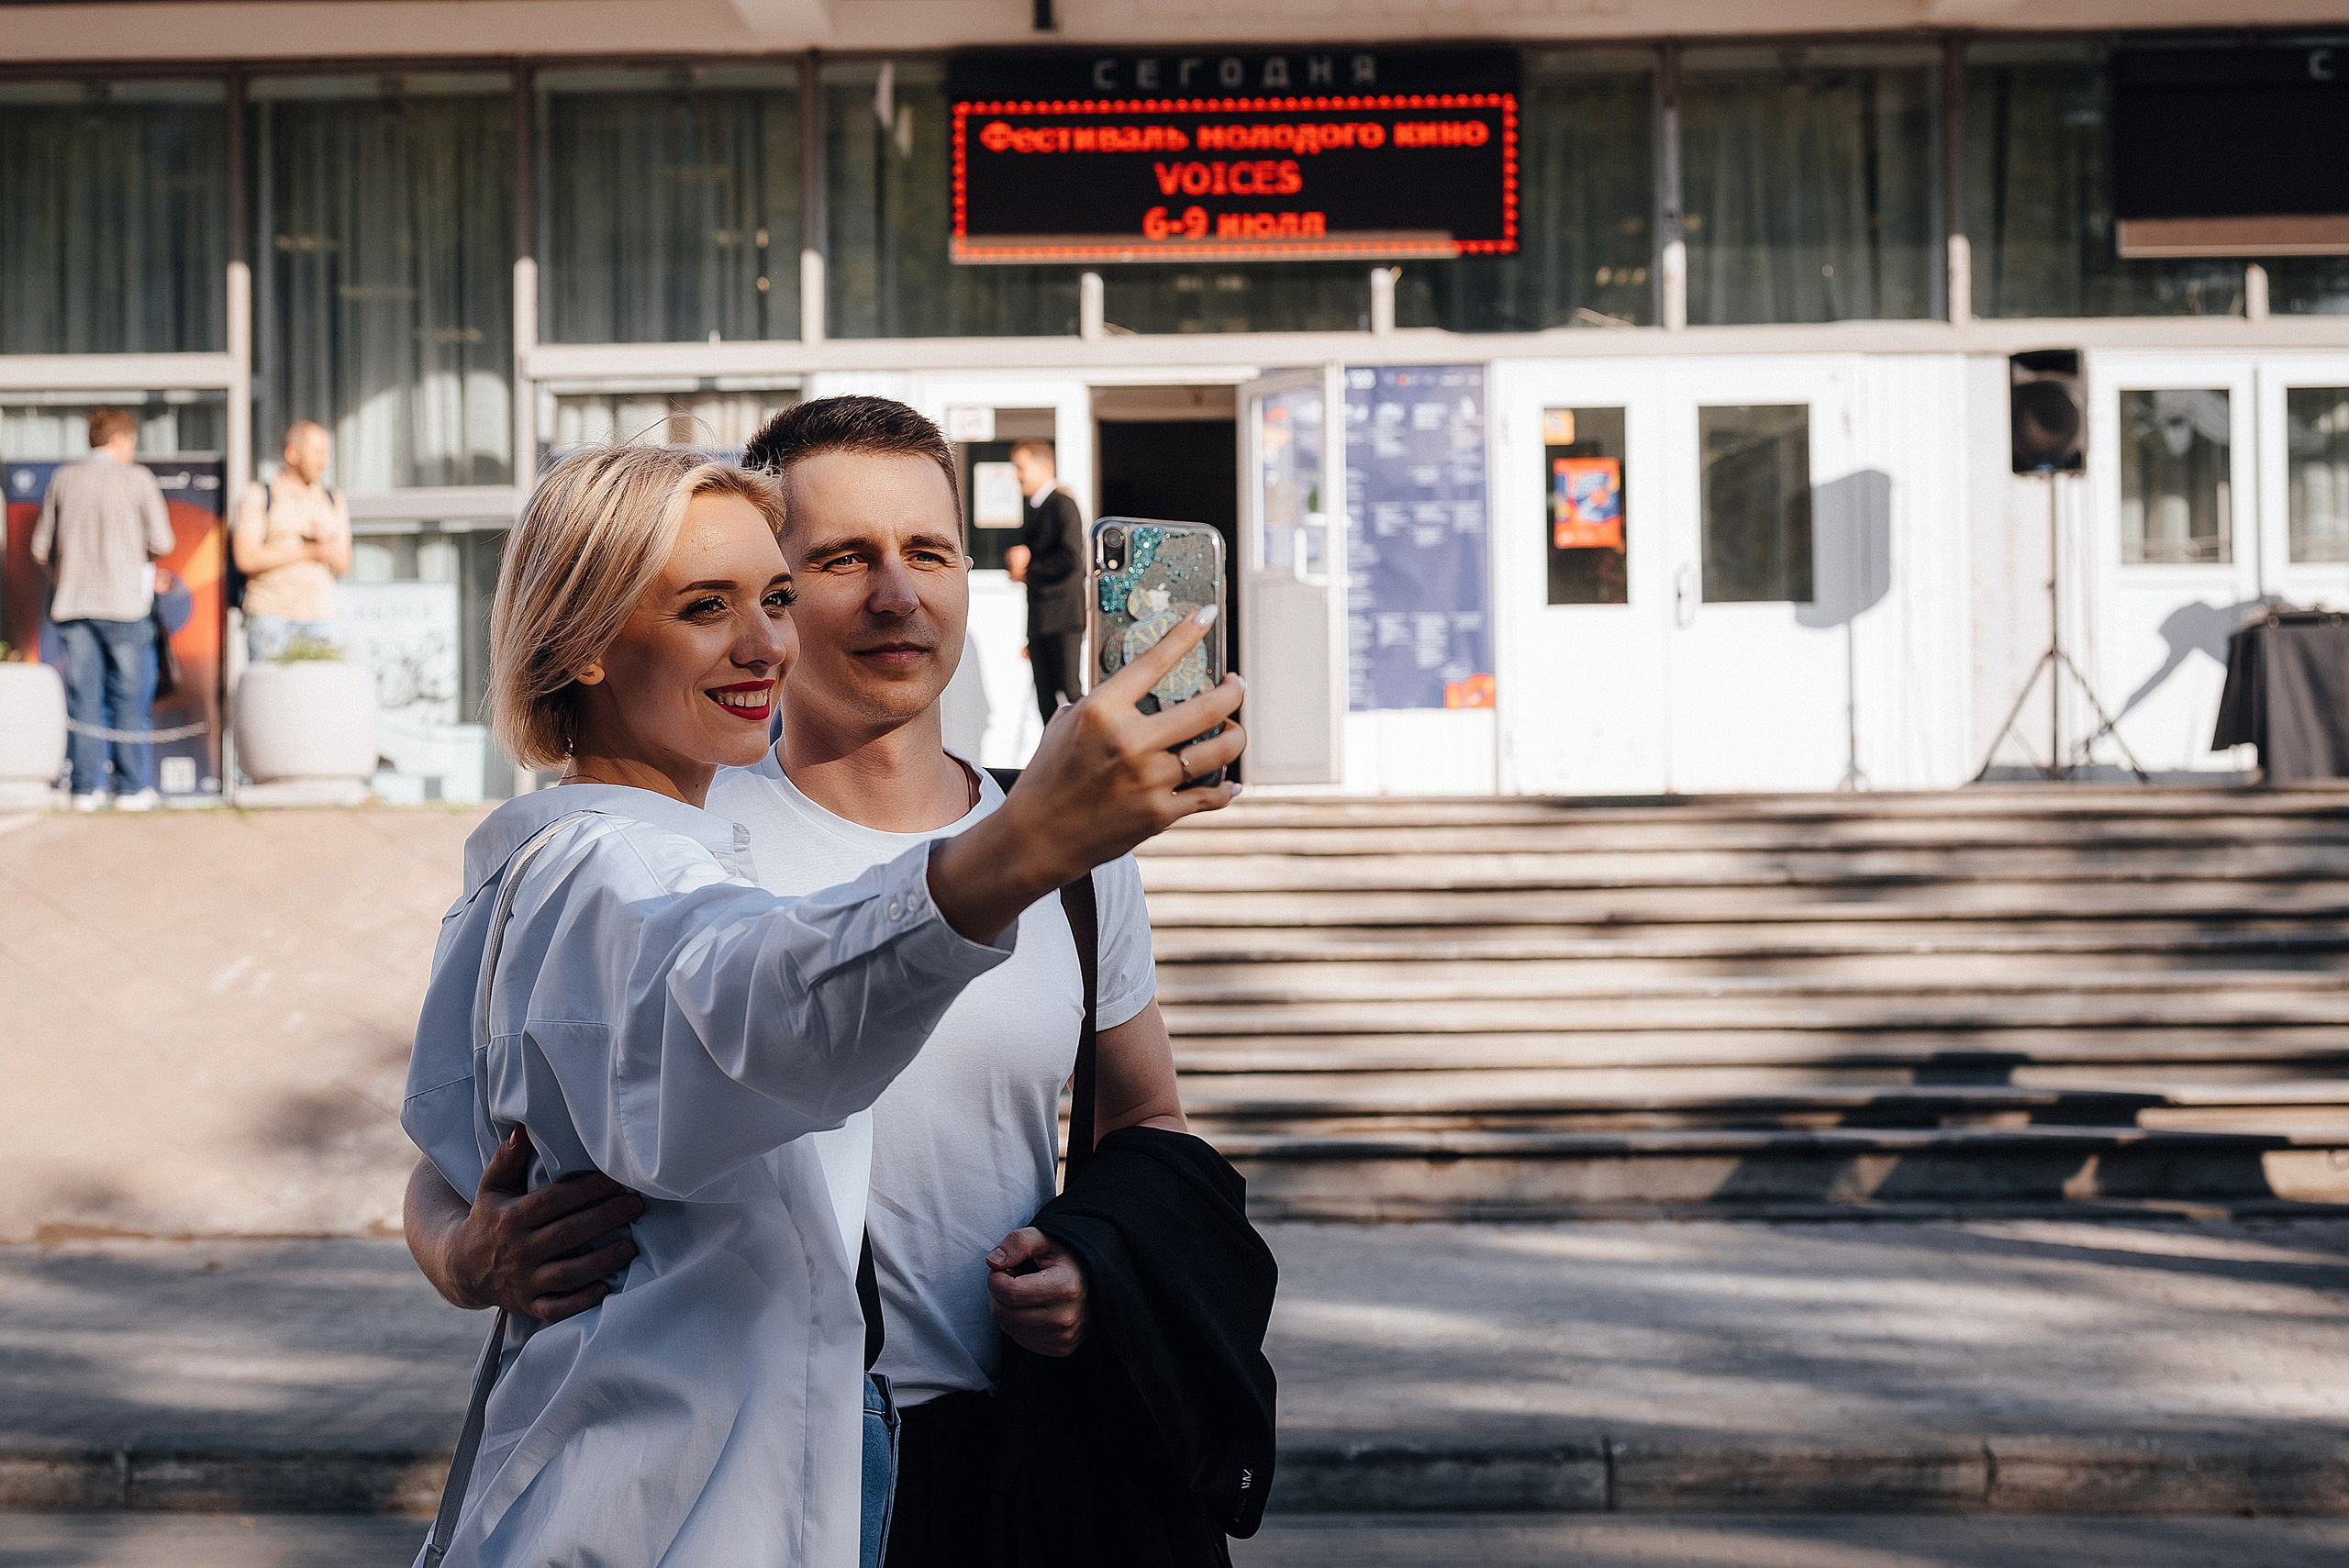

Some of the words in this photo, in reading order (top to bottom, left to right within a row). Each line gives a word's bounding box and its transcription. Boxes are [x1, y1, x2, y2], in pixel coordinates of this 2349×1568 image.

[1093, 54, 1376, 89] СЕГОДНЯ
[980, 120, 1190, 153] Фестиваль
[1197, 122, 1386, 155] молодого
[1393, 120, 1489, 148] кино
[1153, 160, 1303, 195] VOICES
[1142, 206, 1209, 240] 6-9
[1217, 211, 1326, 240] июля
